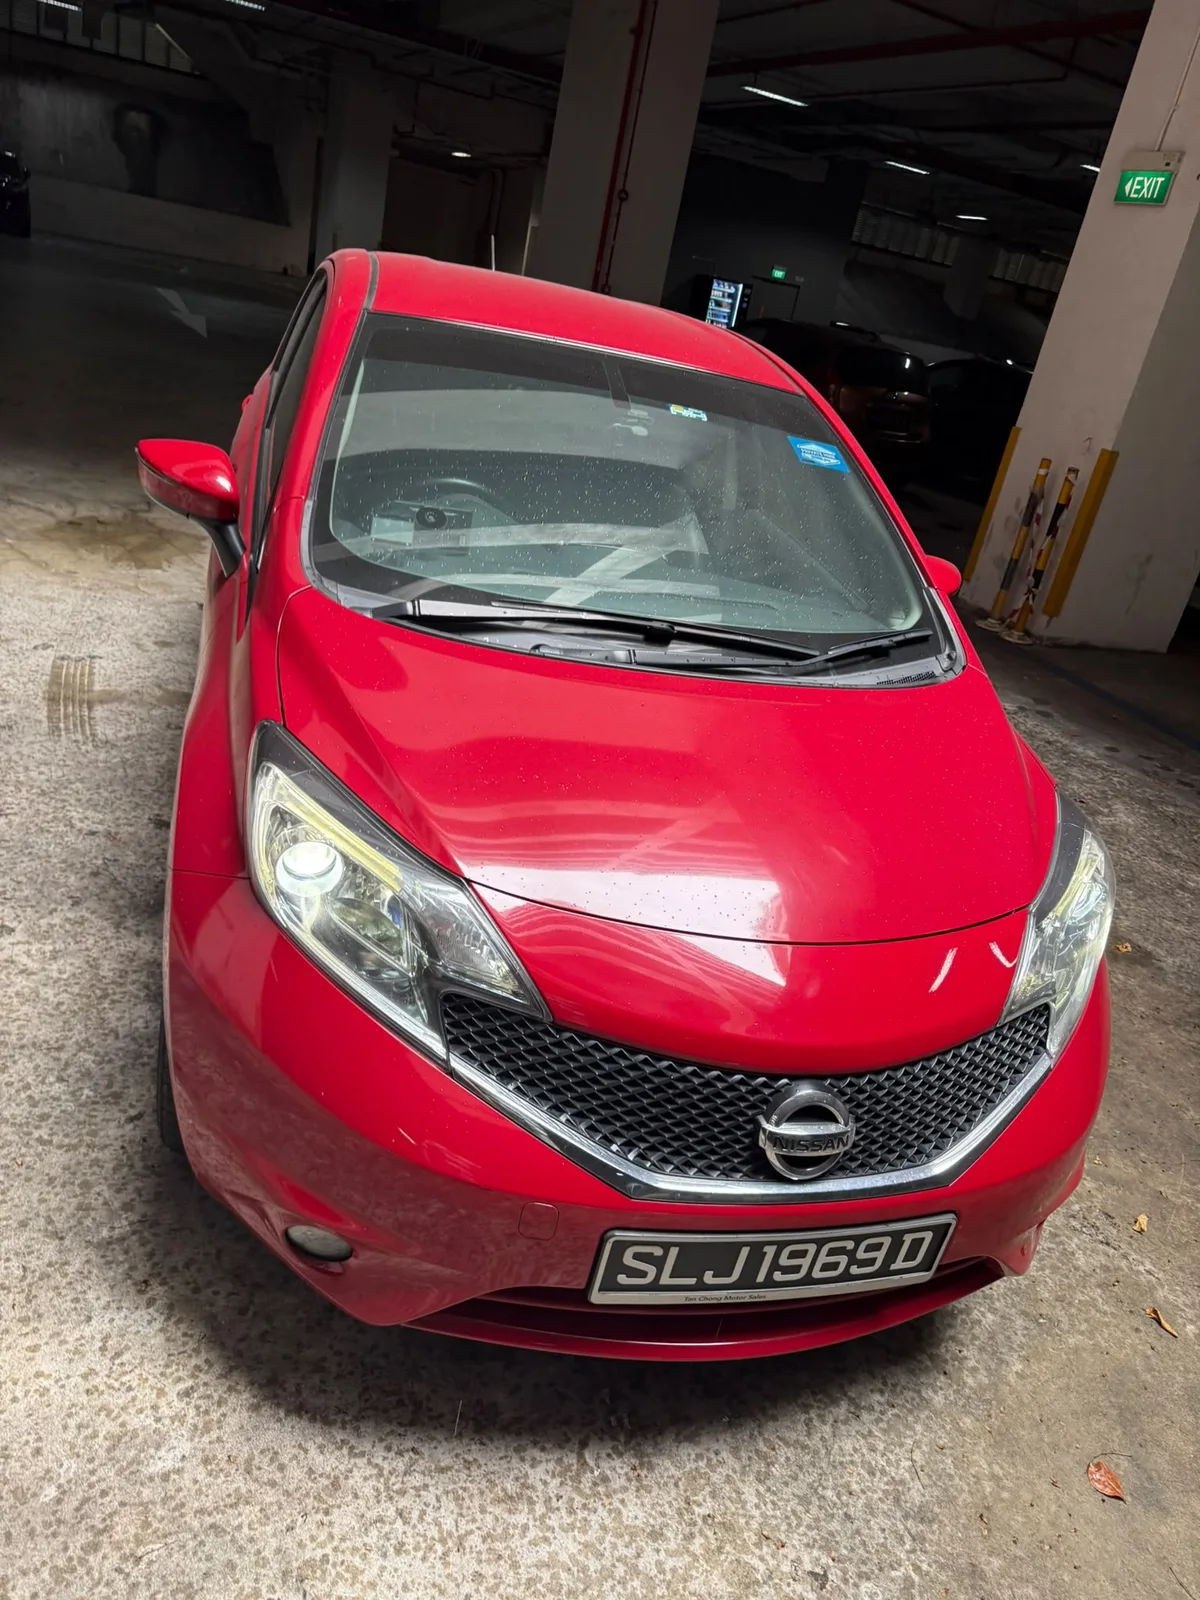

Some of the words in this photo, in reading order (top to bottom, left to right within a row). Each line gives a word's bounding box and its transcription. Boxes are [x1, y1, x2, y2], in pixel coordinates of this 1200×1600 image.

[1130, 177, 1165, 198] EXIT
[773, 1134, 850, 1152] NISSAN
[616, 1230, 935, 1286] SLJ1969D
[698, 1295, 722, 1303] Chong
[723, 1294, 747, 1302] Motor
[748, 1293, 767, 1301] Sales
